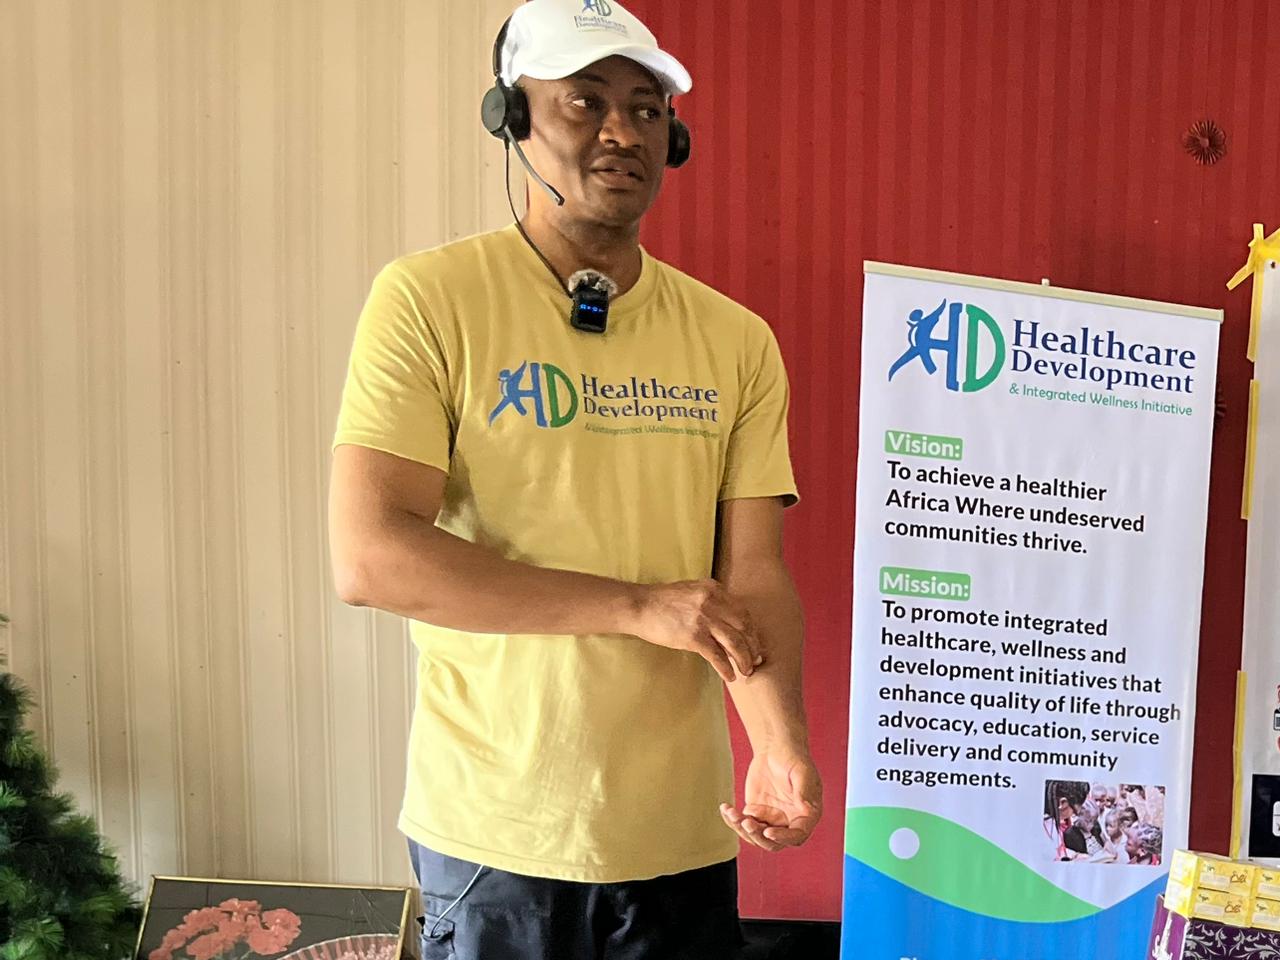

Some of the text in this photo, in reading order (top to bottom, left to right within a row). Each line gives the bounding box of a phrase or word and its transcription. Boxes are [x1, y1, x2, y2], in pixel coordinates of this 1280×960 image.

[1012, 319, 1196, 370] Healthcare
[581, 374, 718, 403] Healthcare
[1011, 349, 1194, 394] Development
[584, 397, 718, 422] Development
[1023, 385, 1193, 416] Integrated Wellness Initiative
[887, 432, 961, 458] Vision:
[887, 461, 1106, 501] To achieve a healthier
[885, 489, 1145, 532] Africa Where undeserved
[884, 520, 1087, 554] communities thrive.
